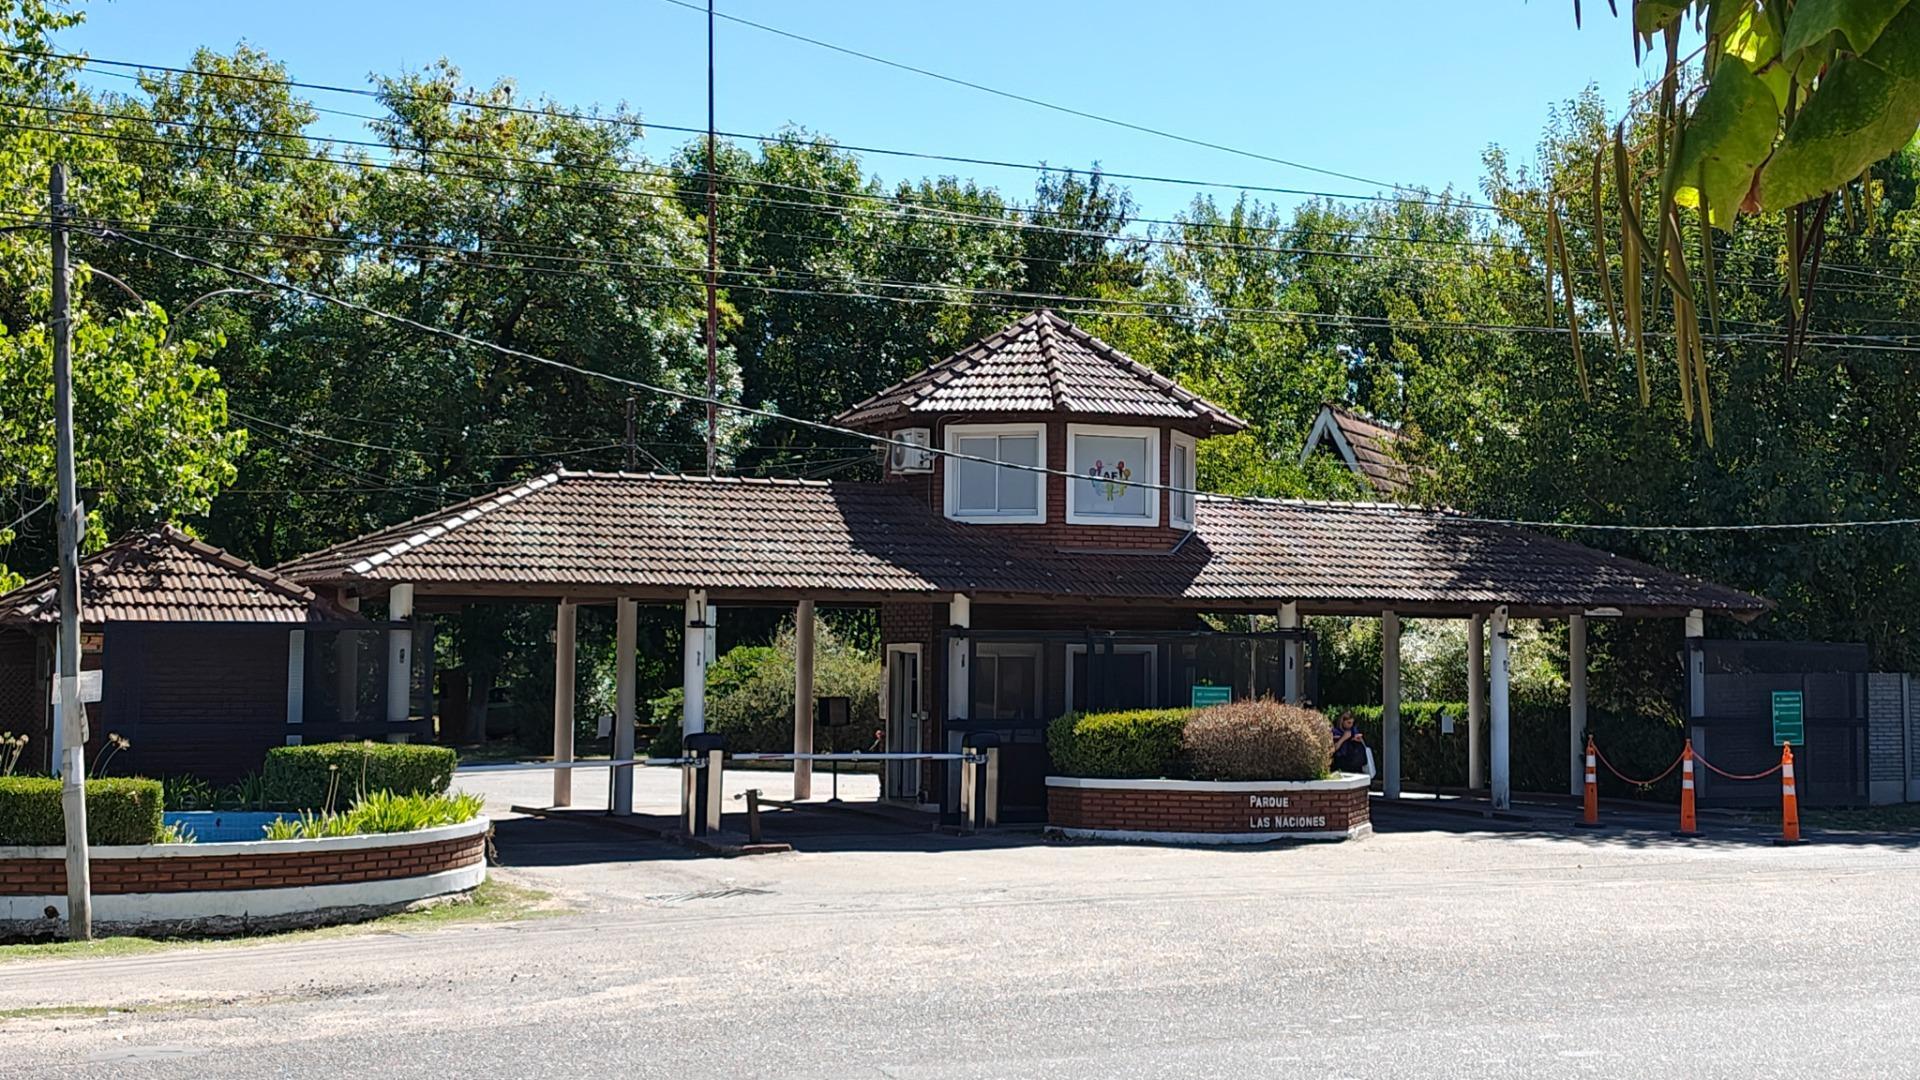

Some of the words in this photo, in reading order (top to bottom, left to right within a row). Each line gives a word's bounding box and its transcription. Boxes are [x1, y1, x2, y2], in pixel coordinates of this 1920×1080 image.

[1249, 795, 1289, 808] PARQUE
[1249, 816, 1271, 828] LAS
[1275, 816, 1326, 828] NACIONES
